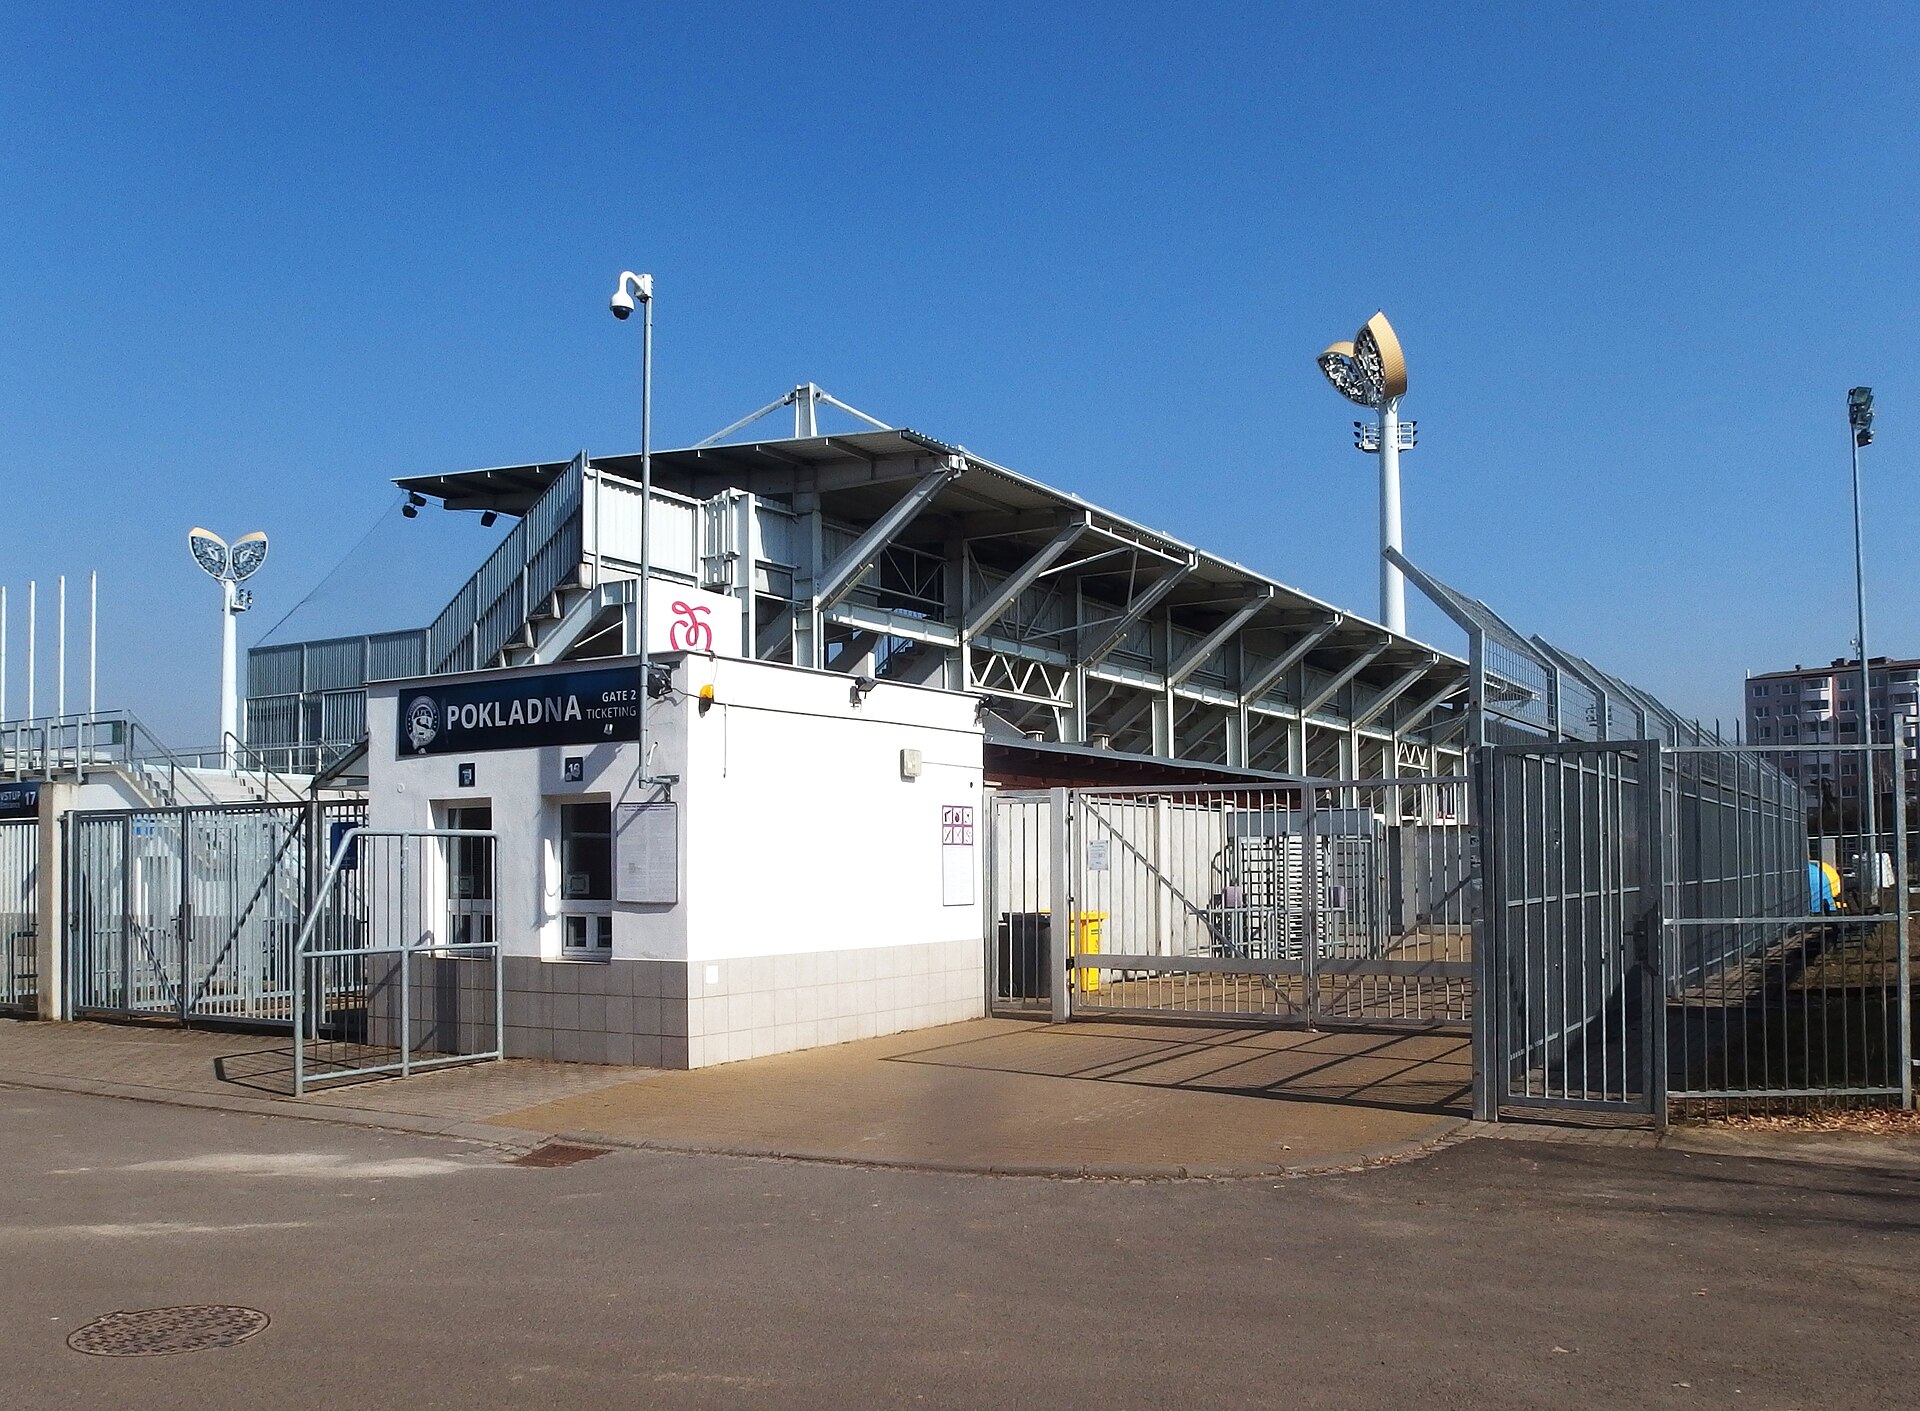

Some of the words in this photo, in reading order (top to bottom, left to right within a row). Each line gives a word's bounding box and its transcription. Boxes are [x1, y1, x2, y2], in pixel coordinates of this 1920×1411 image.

[602, 690, 628, 703] GATE
[630, 689, 637, 700] 2
[447, 694, 582, 731] POKLADNA
[586, 705, 637, 720] TICKETING
[24, 791, 36, 806] 17
